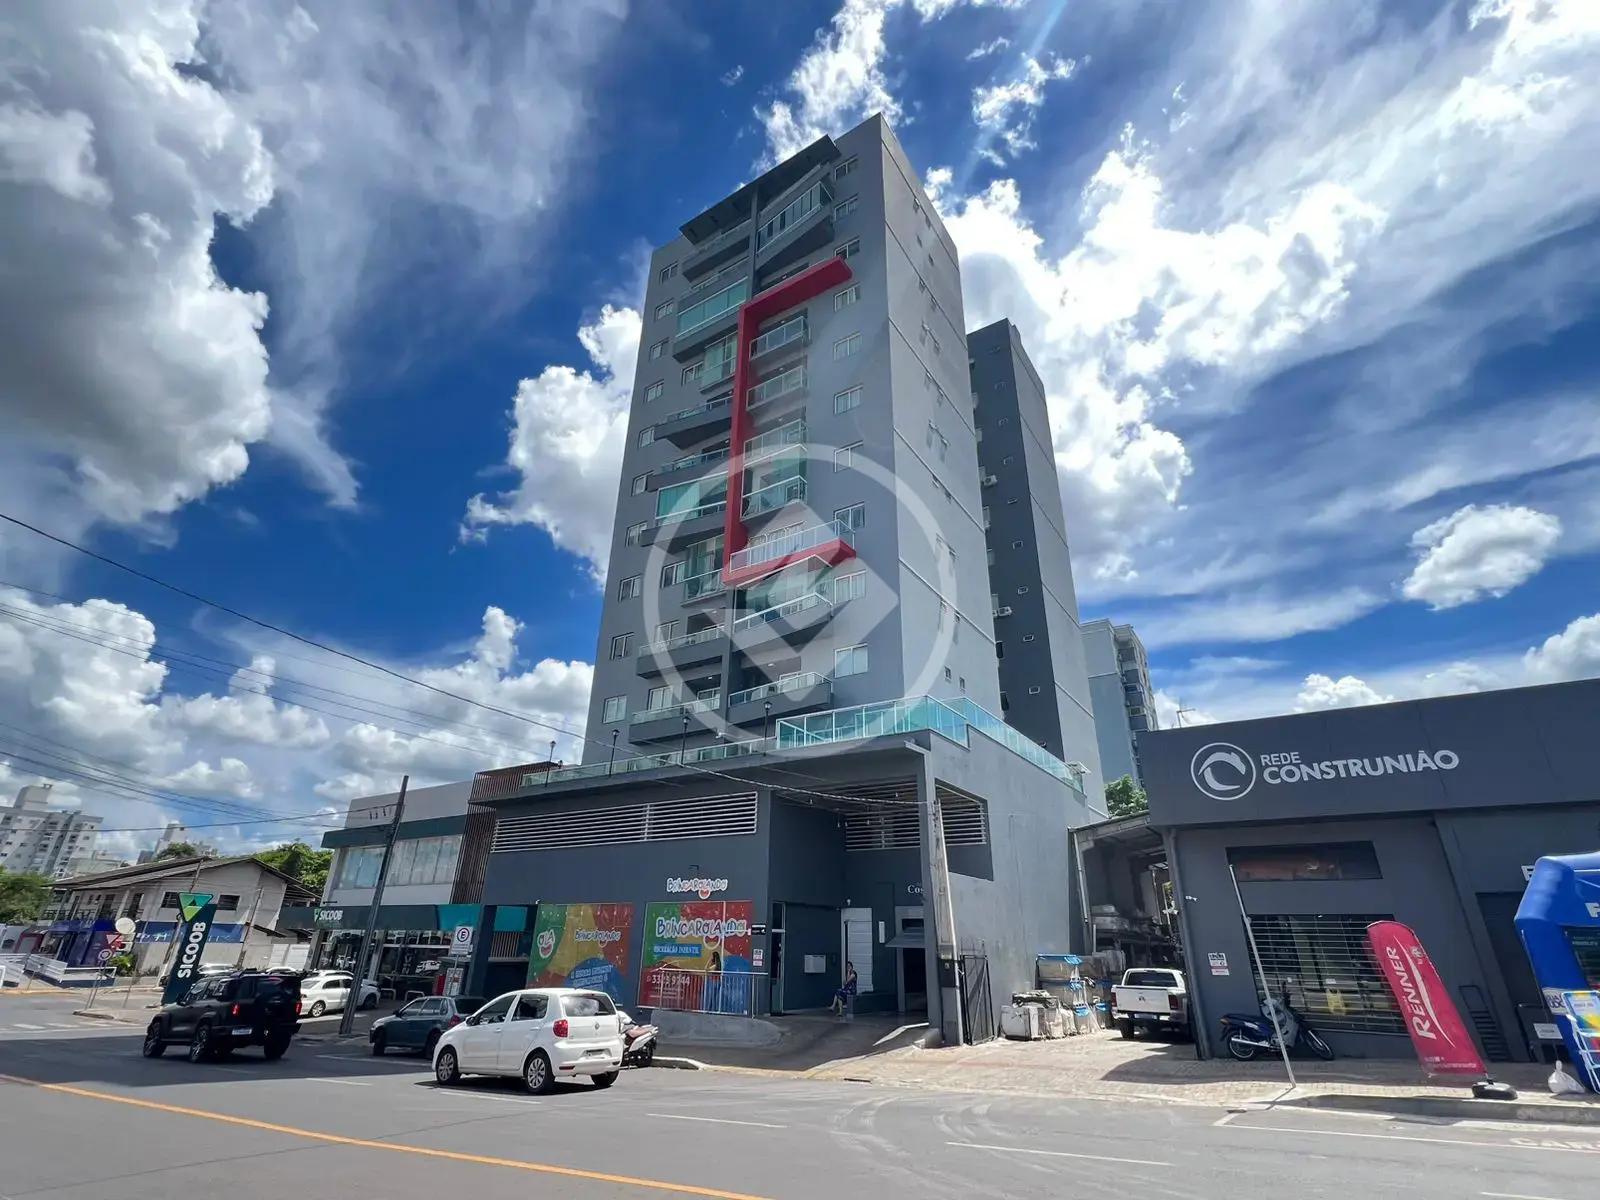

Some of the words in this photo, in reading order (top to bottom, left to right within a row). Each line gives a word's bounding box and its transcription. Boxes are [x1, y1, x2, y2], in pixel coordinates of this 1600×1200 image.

[1260, 752, 1301, 766] REDE
[1263, 749, 1460, 785] CONSTRUNIÃO
[320, 910, 344, 921] SICOOB
[177, 922, 207, 979] SICOOB
[1386, 946, 1437, 1040] RENNER
